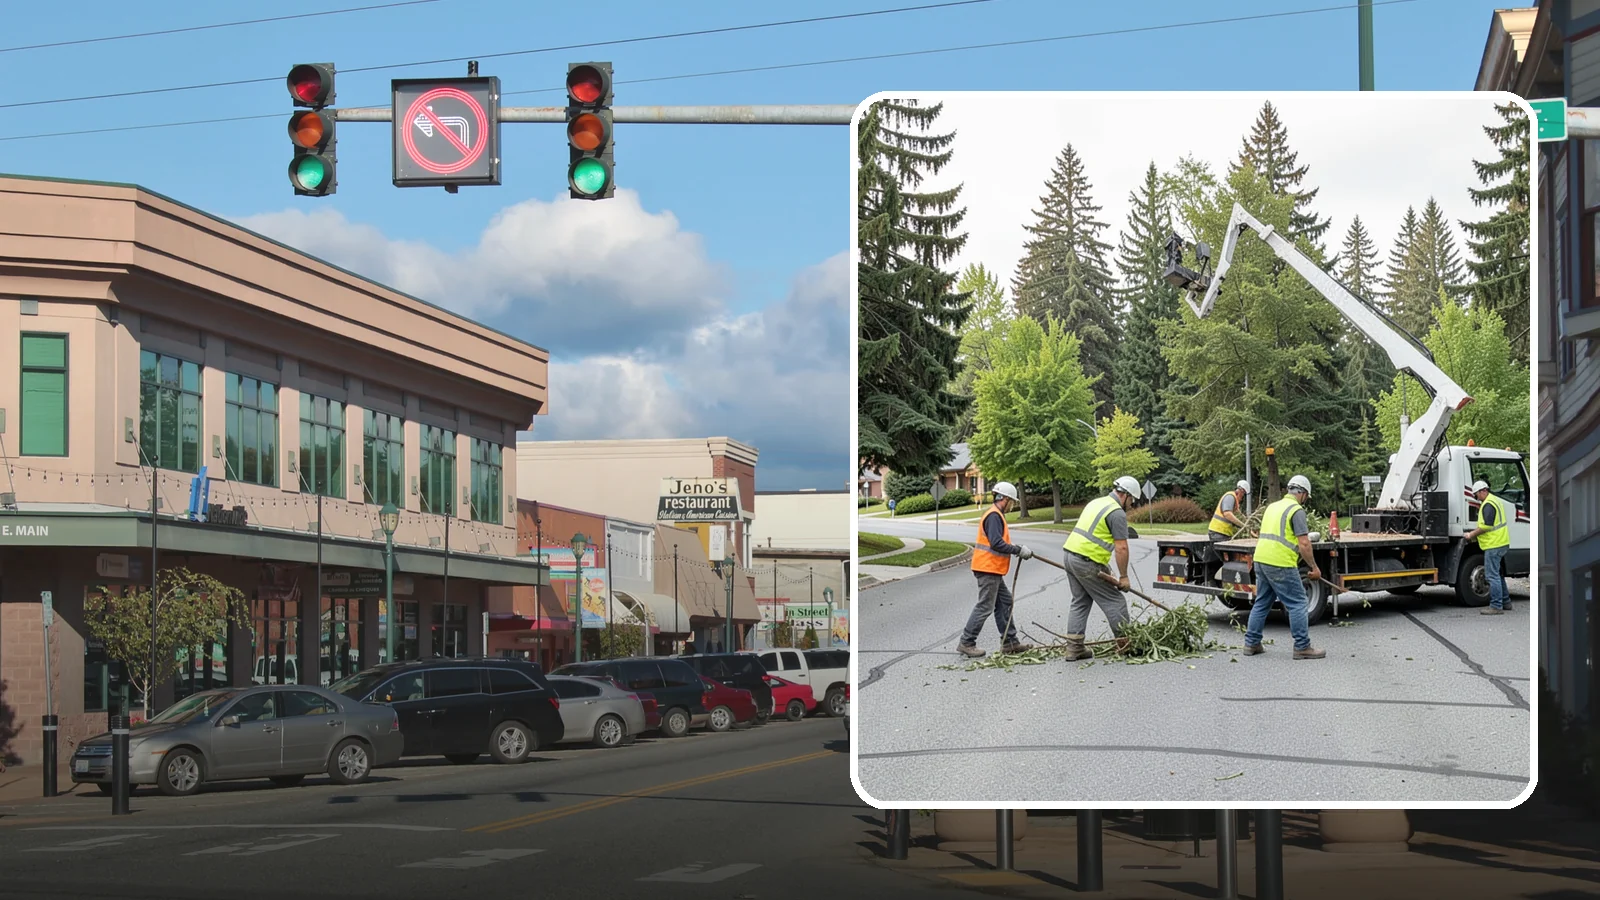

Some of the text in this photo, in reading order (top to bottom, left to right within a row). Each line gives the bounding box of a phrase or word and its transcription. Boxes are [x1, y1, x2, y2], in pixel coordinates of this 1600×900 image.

[669, 480, 727, 494] Jeno's
[665, 496, 731, 509] restaurant
[658, 509, 682, 519] Italian
[685, 509, 714, 519] American
[715, 509, 737, 519] Cuisine
[2, 525, 49, 536] E. MAIN
[797, 608, 828, 616] Street
